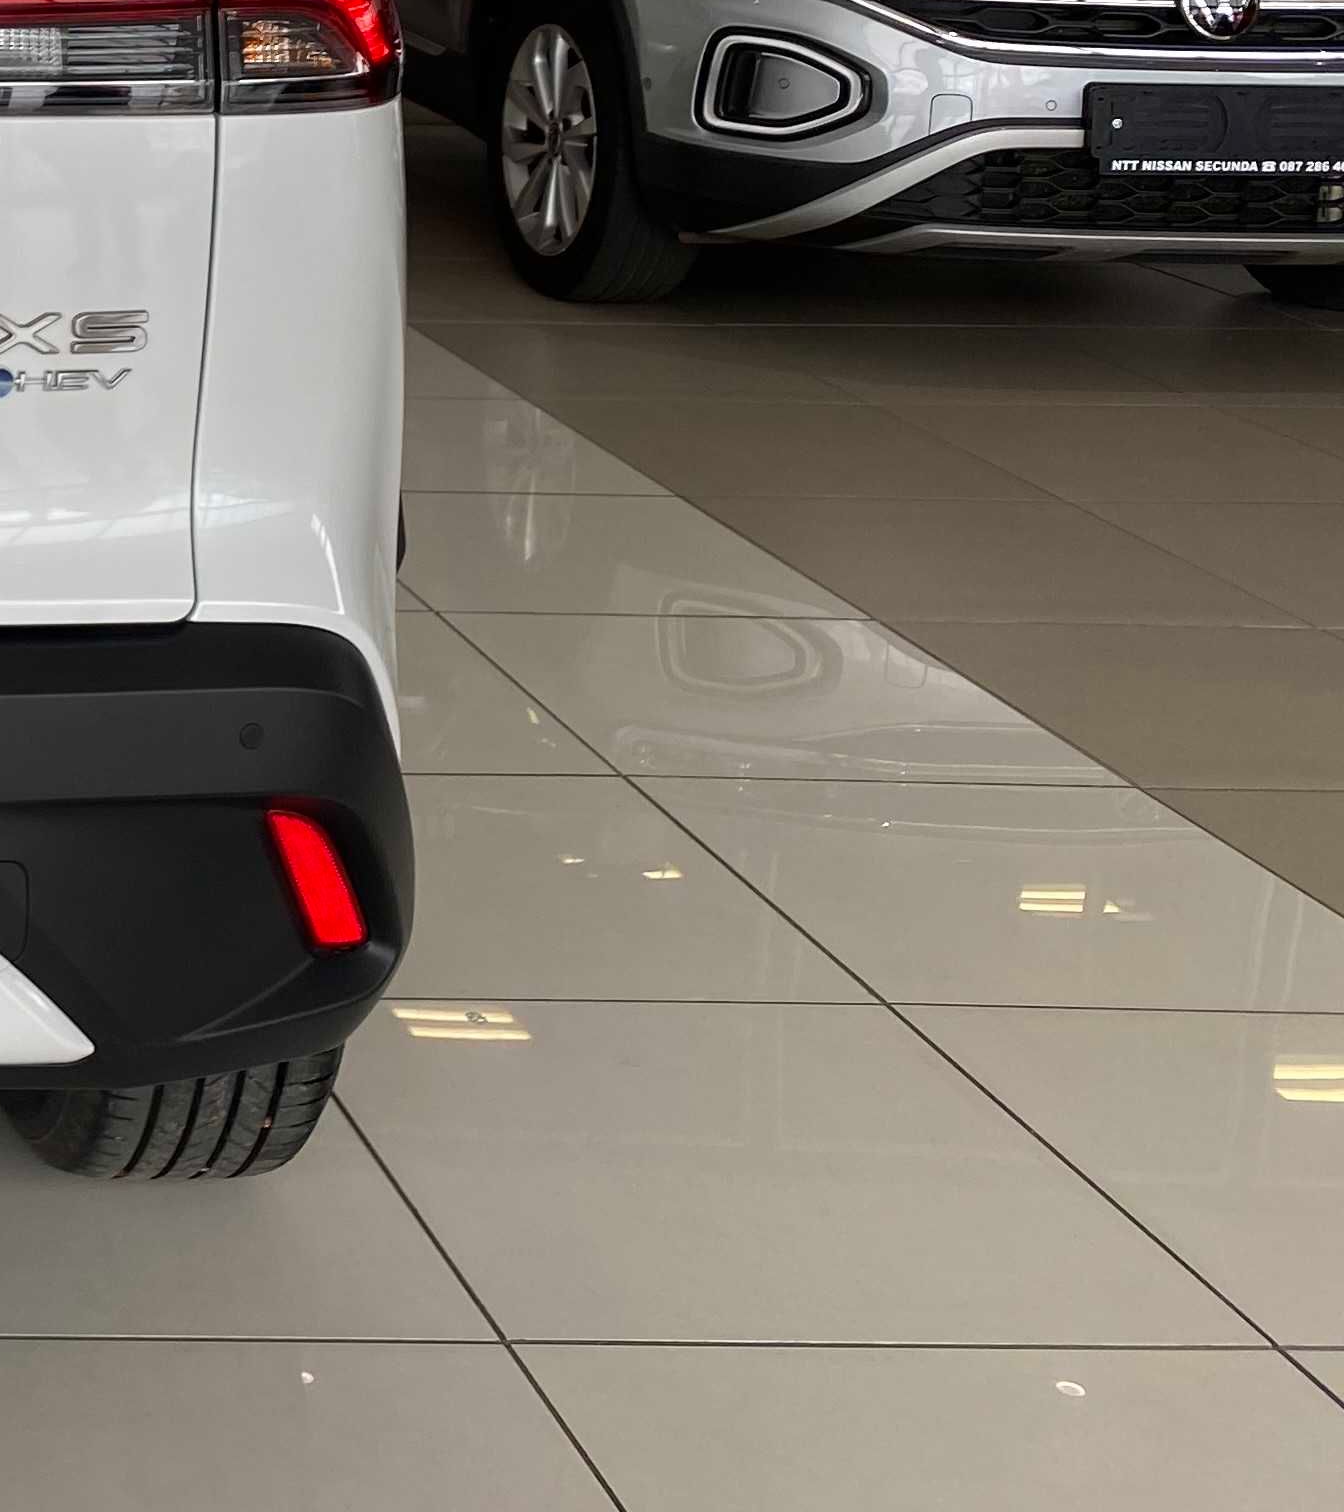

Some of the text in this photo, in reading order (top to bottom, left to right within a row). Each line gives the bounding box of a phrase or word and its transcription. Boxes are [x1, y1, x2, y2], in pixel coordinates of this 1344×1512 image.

[1112, 159, 1139, 171] NTT
[1141, 160, 1192, 172] NISSAN
[1195, 160, 1258, 172] SECUNDA
[1279, 161, 1302, 172] 087
[1305, 161, 1330, 172] 286
